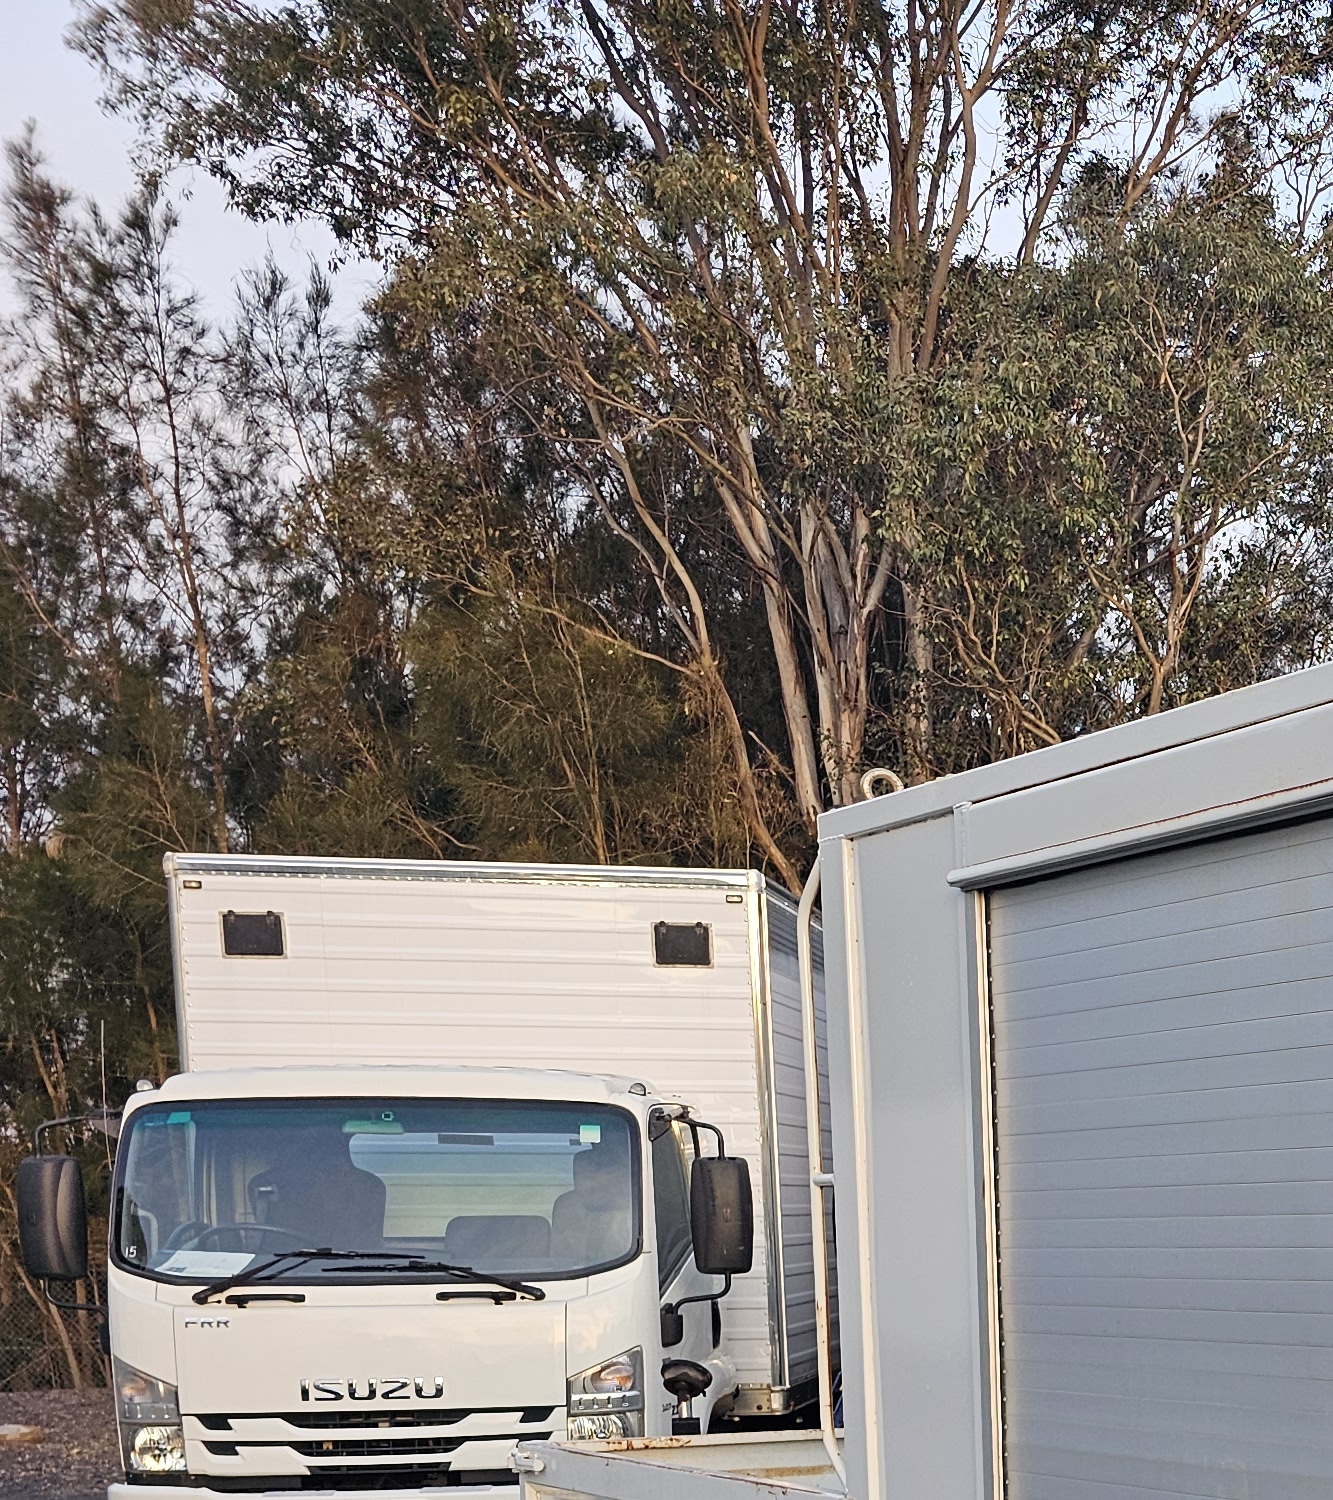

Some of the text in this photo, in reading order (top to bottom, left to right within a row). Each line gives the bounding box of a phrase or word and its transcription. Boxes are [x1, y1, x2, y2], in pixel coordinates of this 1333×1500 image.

[124, 1245, 137, 1259] 15
[184, 1316, 230, 1329] FRR
[299, 1376, 445, 1402] ISUZU
